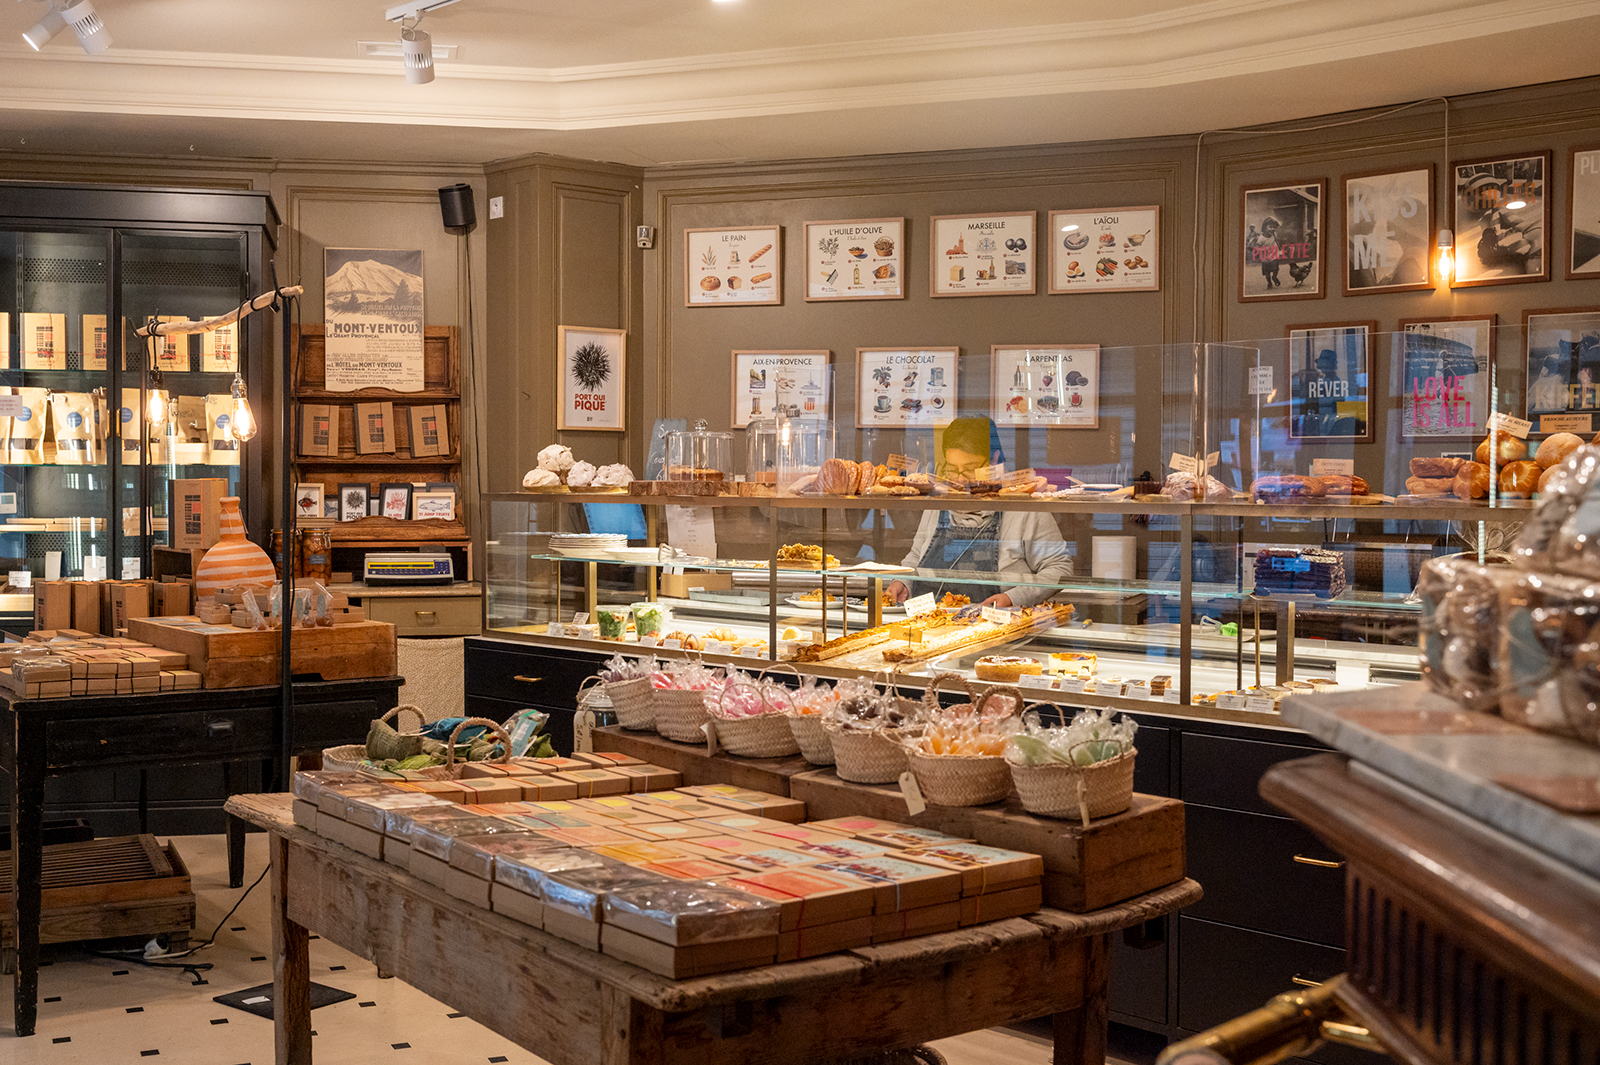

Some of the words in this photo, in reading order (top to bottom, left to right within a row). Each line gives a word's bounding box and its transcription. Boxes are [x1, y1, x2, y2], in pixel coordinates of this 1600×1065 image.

[1580, 155, 1600, 175] PL
[967, 221, 1006, 230] MARSEILLE
[1093, 215, 1119, 225] L'AÏOLI
[855, 226, 883, 235] D'OLIVE
[730, 234, 747, 242] PAIN
[1252, 242, 1310, 261] POULETTE
[1353, 230, 1396, 271] ME
[334, 323, 422, 334] MONT-VENTOUX
[752, 358, 813, 366] AIX-EN-PROVENCE
[886, 356, 894, 364] LE
[895, 355, 936, 364] CHOCOLAT
[1024, 355, 1073, 363] CARPENTAS
[1308, 377, 1349, 398] RÊVER
[1413, 375, 1466, 402] LOVE
[574, 400, 606, 411] PIQUE
[1412, 402, 1432, 428] IS
[1437, 401, 1477, 427] ALL
